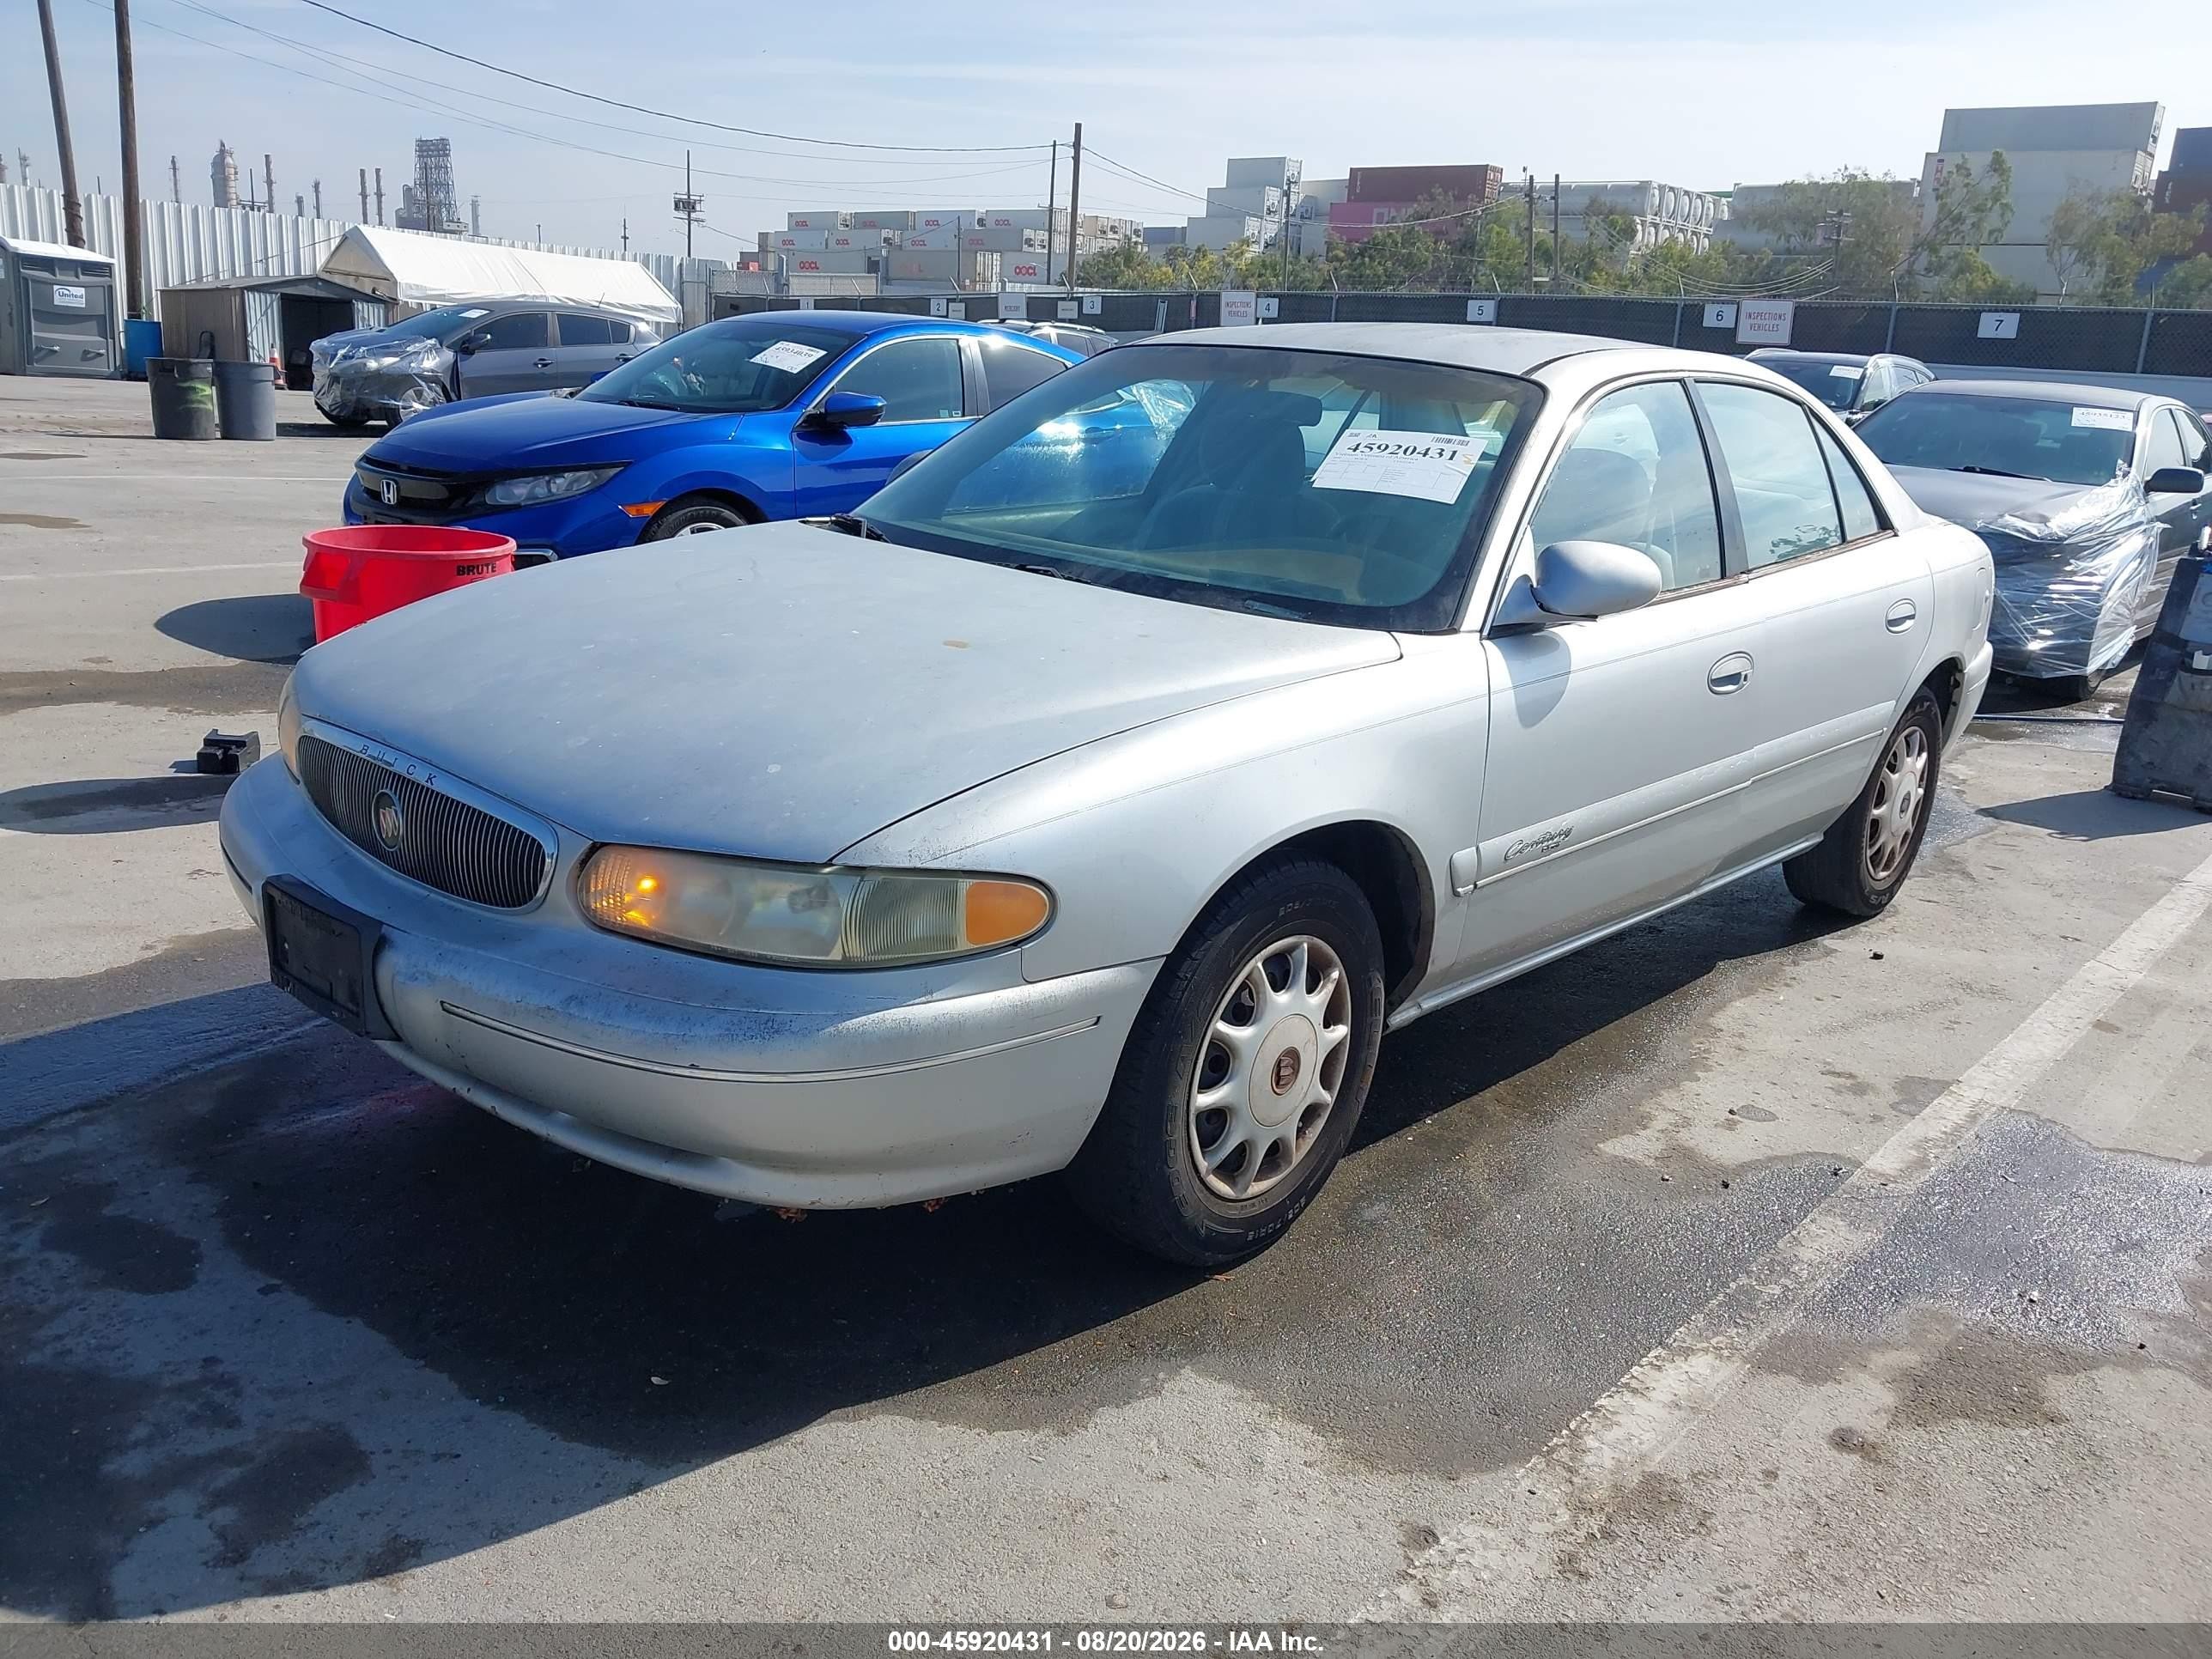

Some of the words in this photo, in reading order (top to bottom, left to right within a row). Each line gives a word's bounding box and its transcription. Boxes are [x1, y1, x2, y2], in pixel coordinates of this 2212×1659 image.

[799, 260, 819, 270] OOCL
[1014, 265, 1037, 276] OOCL
[58, 290, 83, 299] United
[936, 302, 941, 311] 2
[1089, 301, 1095, 309] 3
[1264, 302, 1271, 313] 4
[1477, 305, 1484, 316] 5
[1716, 310, 1724, 321] 6
[1745, 312, 1786, 321] INSPECTIONS
[1749, 323, 1779, 331] VEHICLES
[1994, 319, 2004, 331] 7
[1346, 441, 1458, 462] 45920431
[456, 563, 496, 576] BRUTE
[360, 744, 437, 786] BUICK
[1504, 825, 1574, 860] Century
